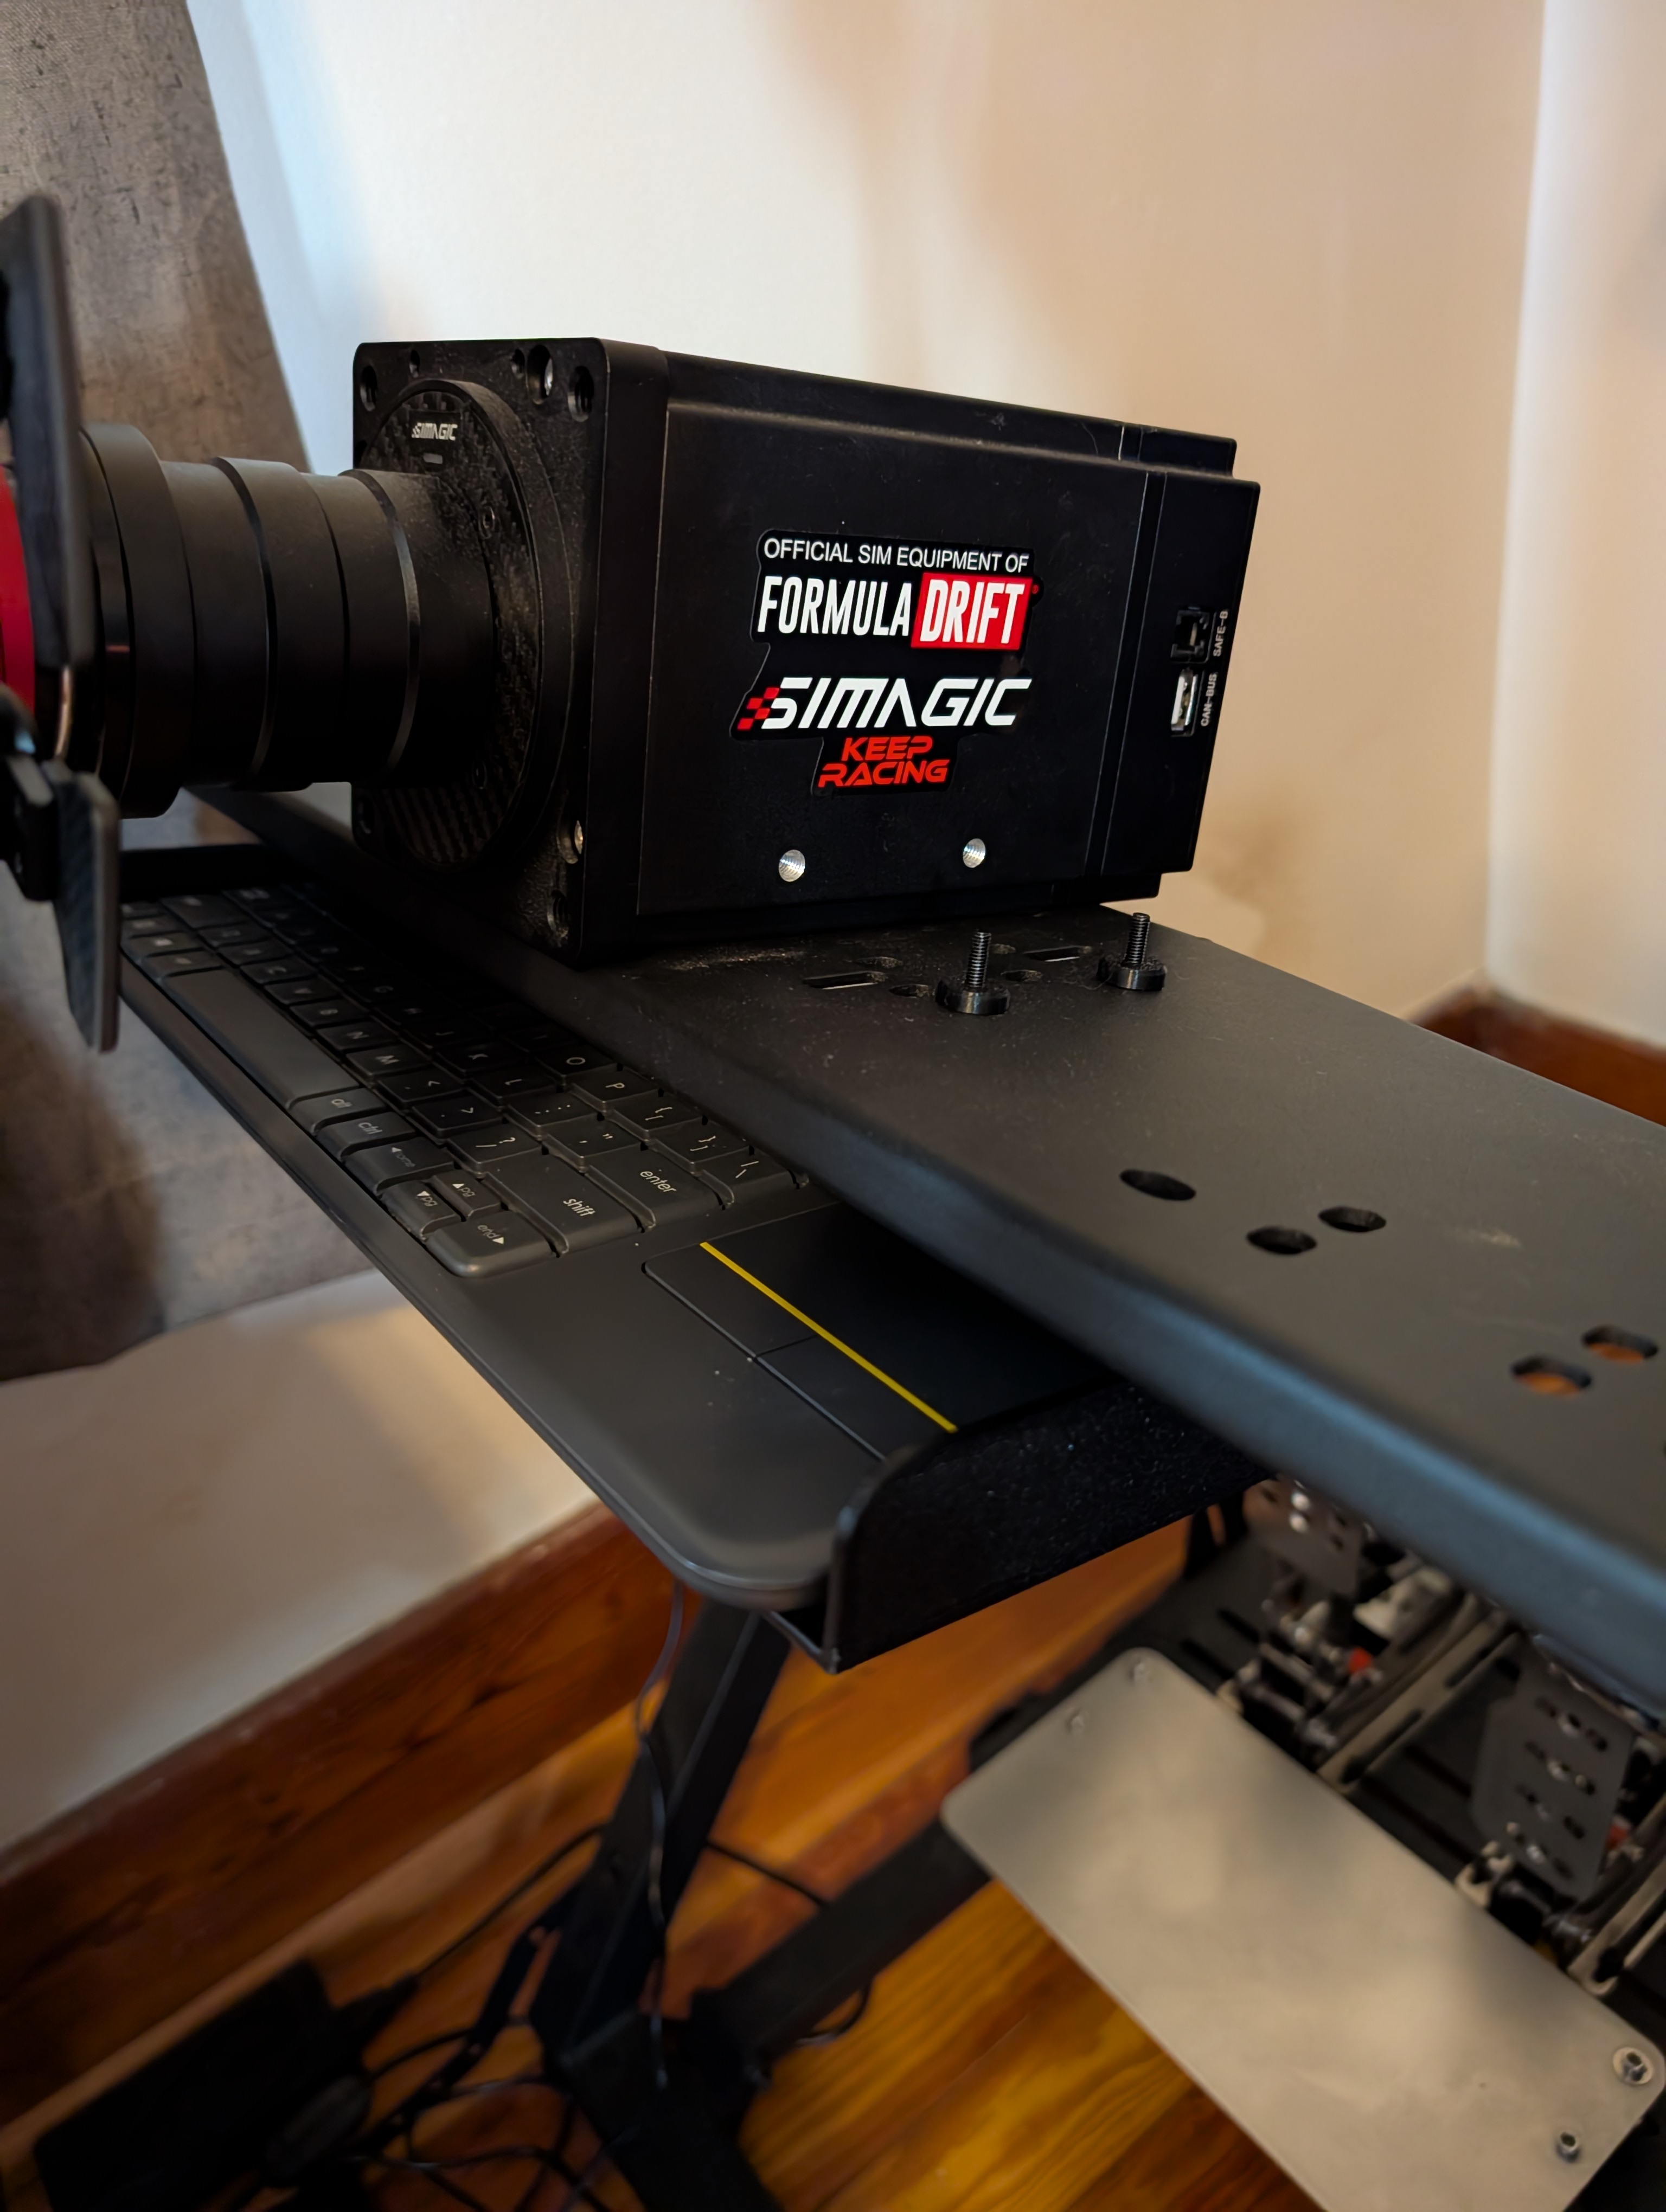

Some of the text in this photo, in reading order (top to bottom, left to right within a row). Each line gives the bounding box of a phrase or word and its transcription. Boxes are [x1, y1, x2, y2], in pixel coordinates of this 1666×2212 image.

[412, 422, 458, 441] SIMAGIC
[764, 537, 1029, 573] OFFICIAL SIM EQUIPMENT OF
[757, 575, 1026, 644] FORMULA DRIFT
[761, 677, 1033, 729] SIMAGIC
[841, 736, 934, 761] KEEP
[818, 759, 950, 788] RACING
[639, 1171, 677, 1193] enter
[563, 1198, 596, 1217] shift
